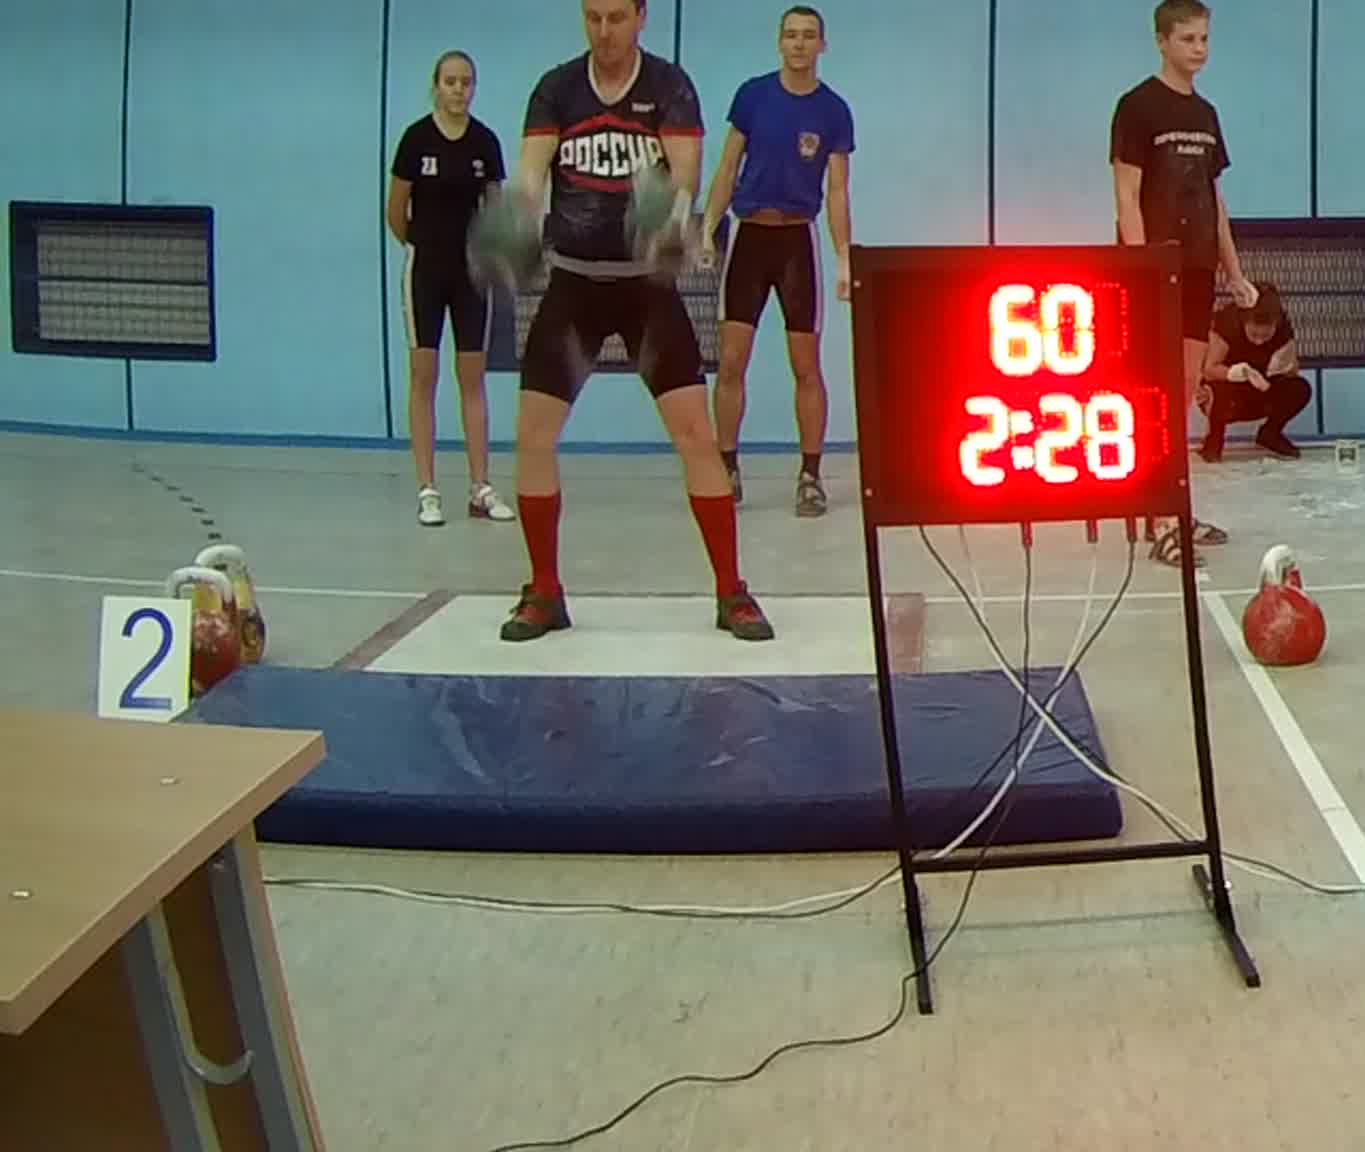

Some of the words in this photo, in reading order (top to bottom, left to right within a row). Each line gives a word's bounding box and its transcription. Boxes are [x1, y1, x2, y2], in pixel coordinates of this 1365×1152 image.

[988, 282, 1096, 377] 60
[959, 392, 1136, 486] 2:28
[119, 607, 174, 710] 2
